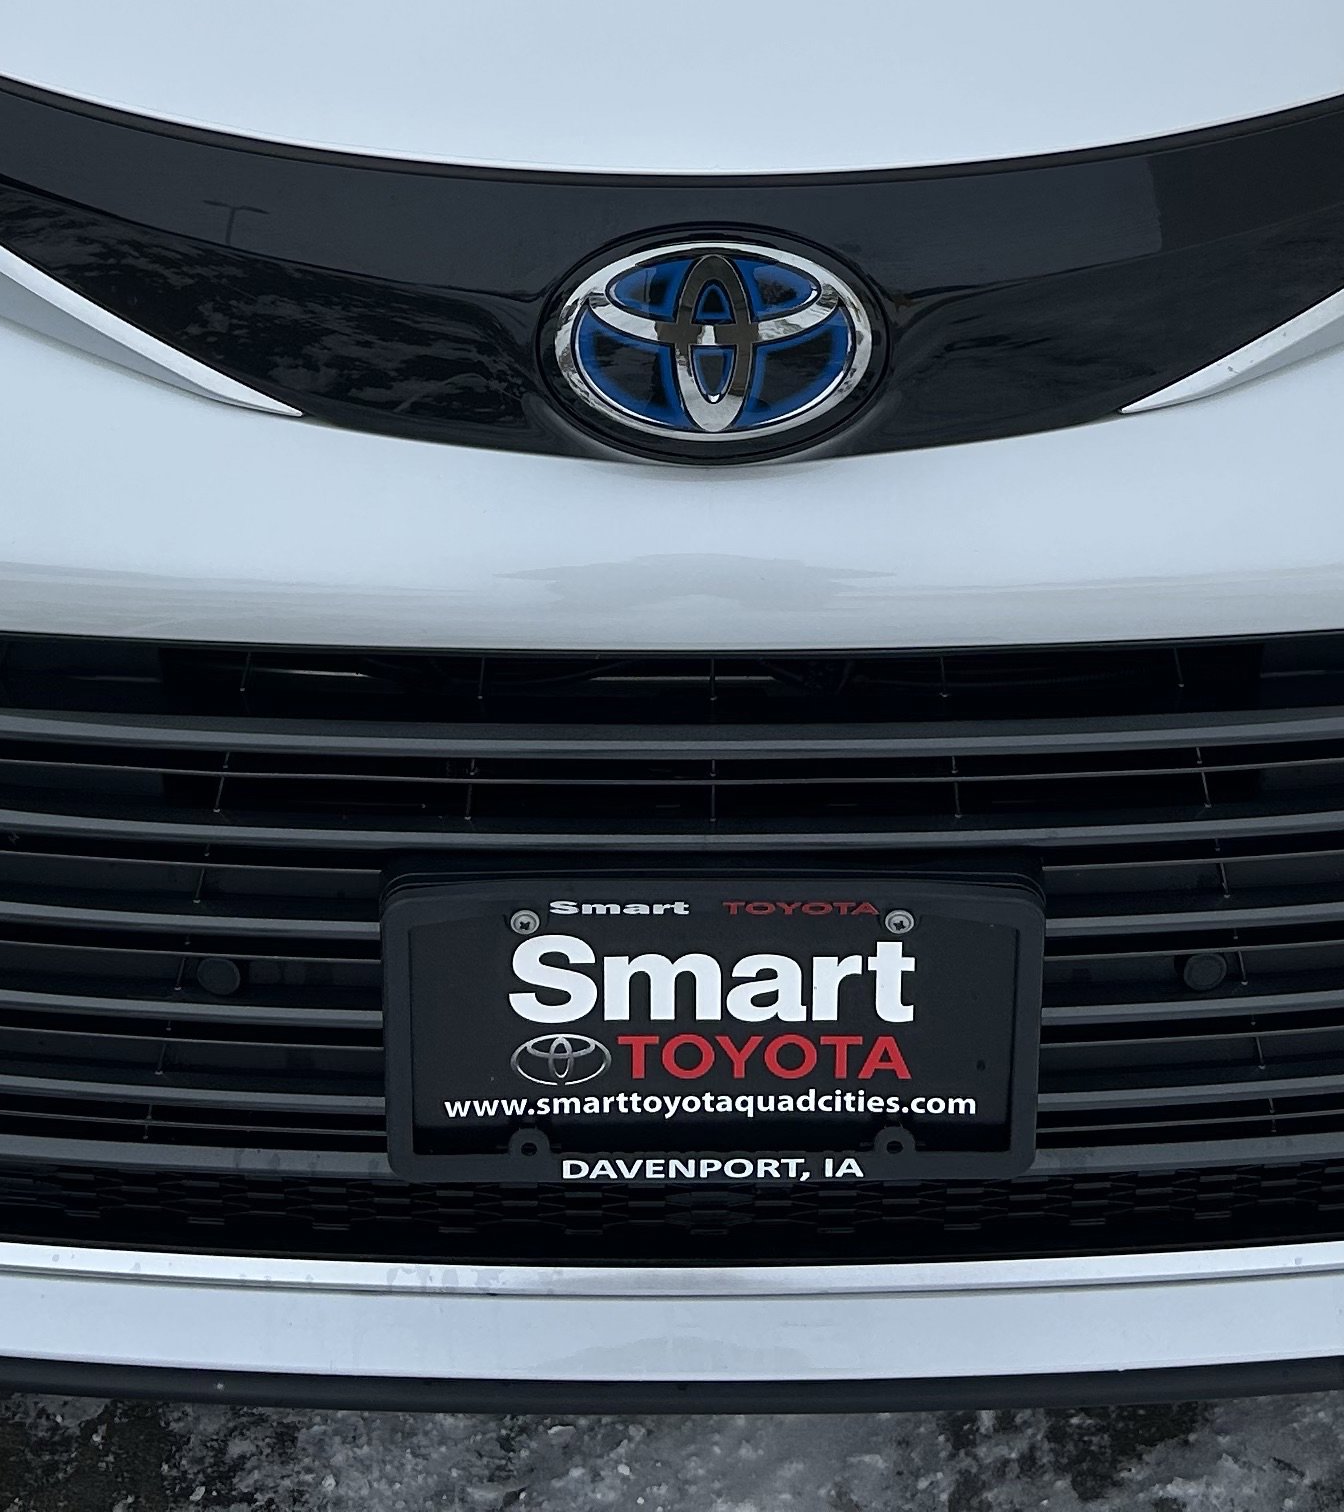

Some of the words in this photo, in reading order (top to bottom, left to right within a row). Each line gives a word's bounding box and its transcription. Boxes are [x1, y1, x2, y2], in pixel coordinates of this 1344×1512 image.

[549, 900, 690, 915] Smart
[722, 901, 881, 915] TOYOTA
[508, 933, 916, 1024] Smart
[616, 1032, 912, 1080] TOYOTA
[443, 1087, 977, 1120] www.smarttoyotaquadcities.com
[561, 1158, 812, 1183] DAVENPORT,
[823, 1158, 865, 1179] IA
